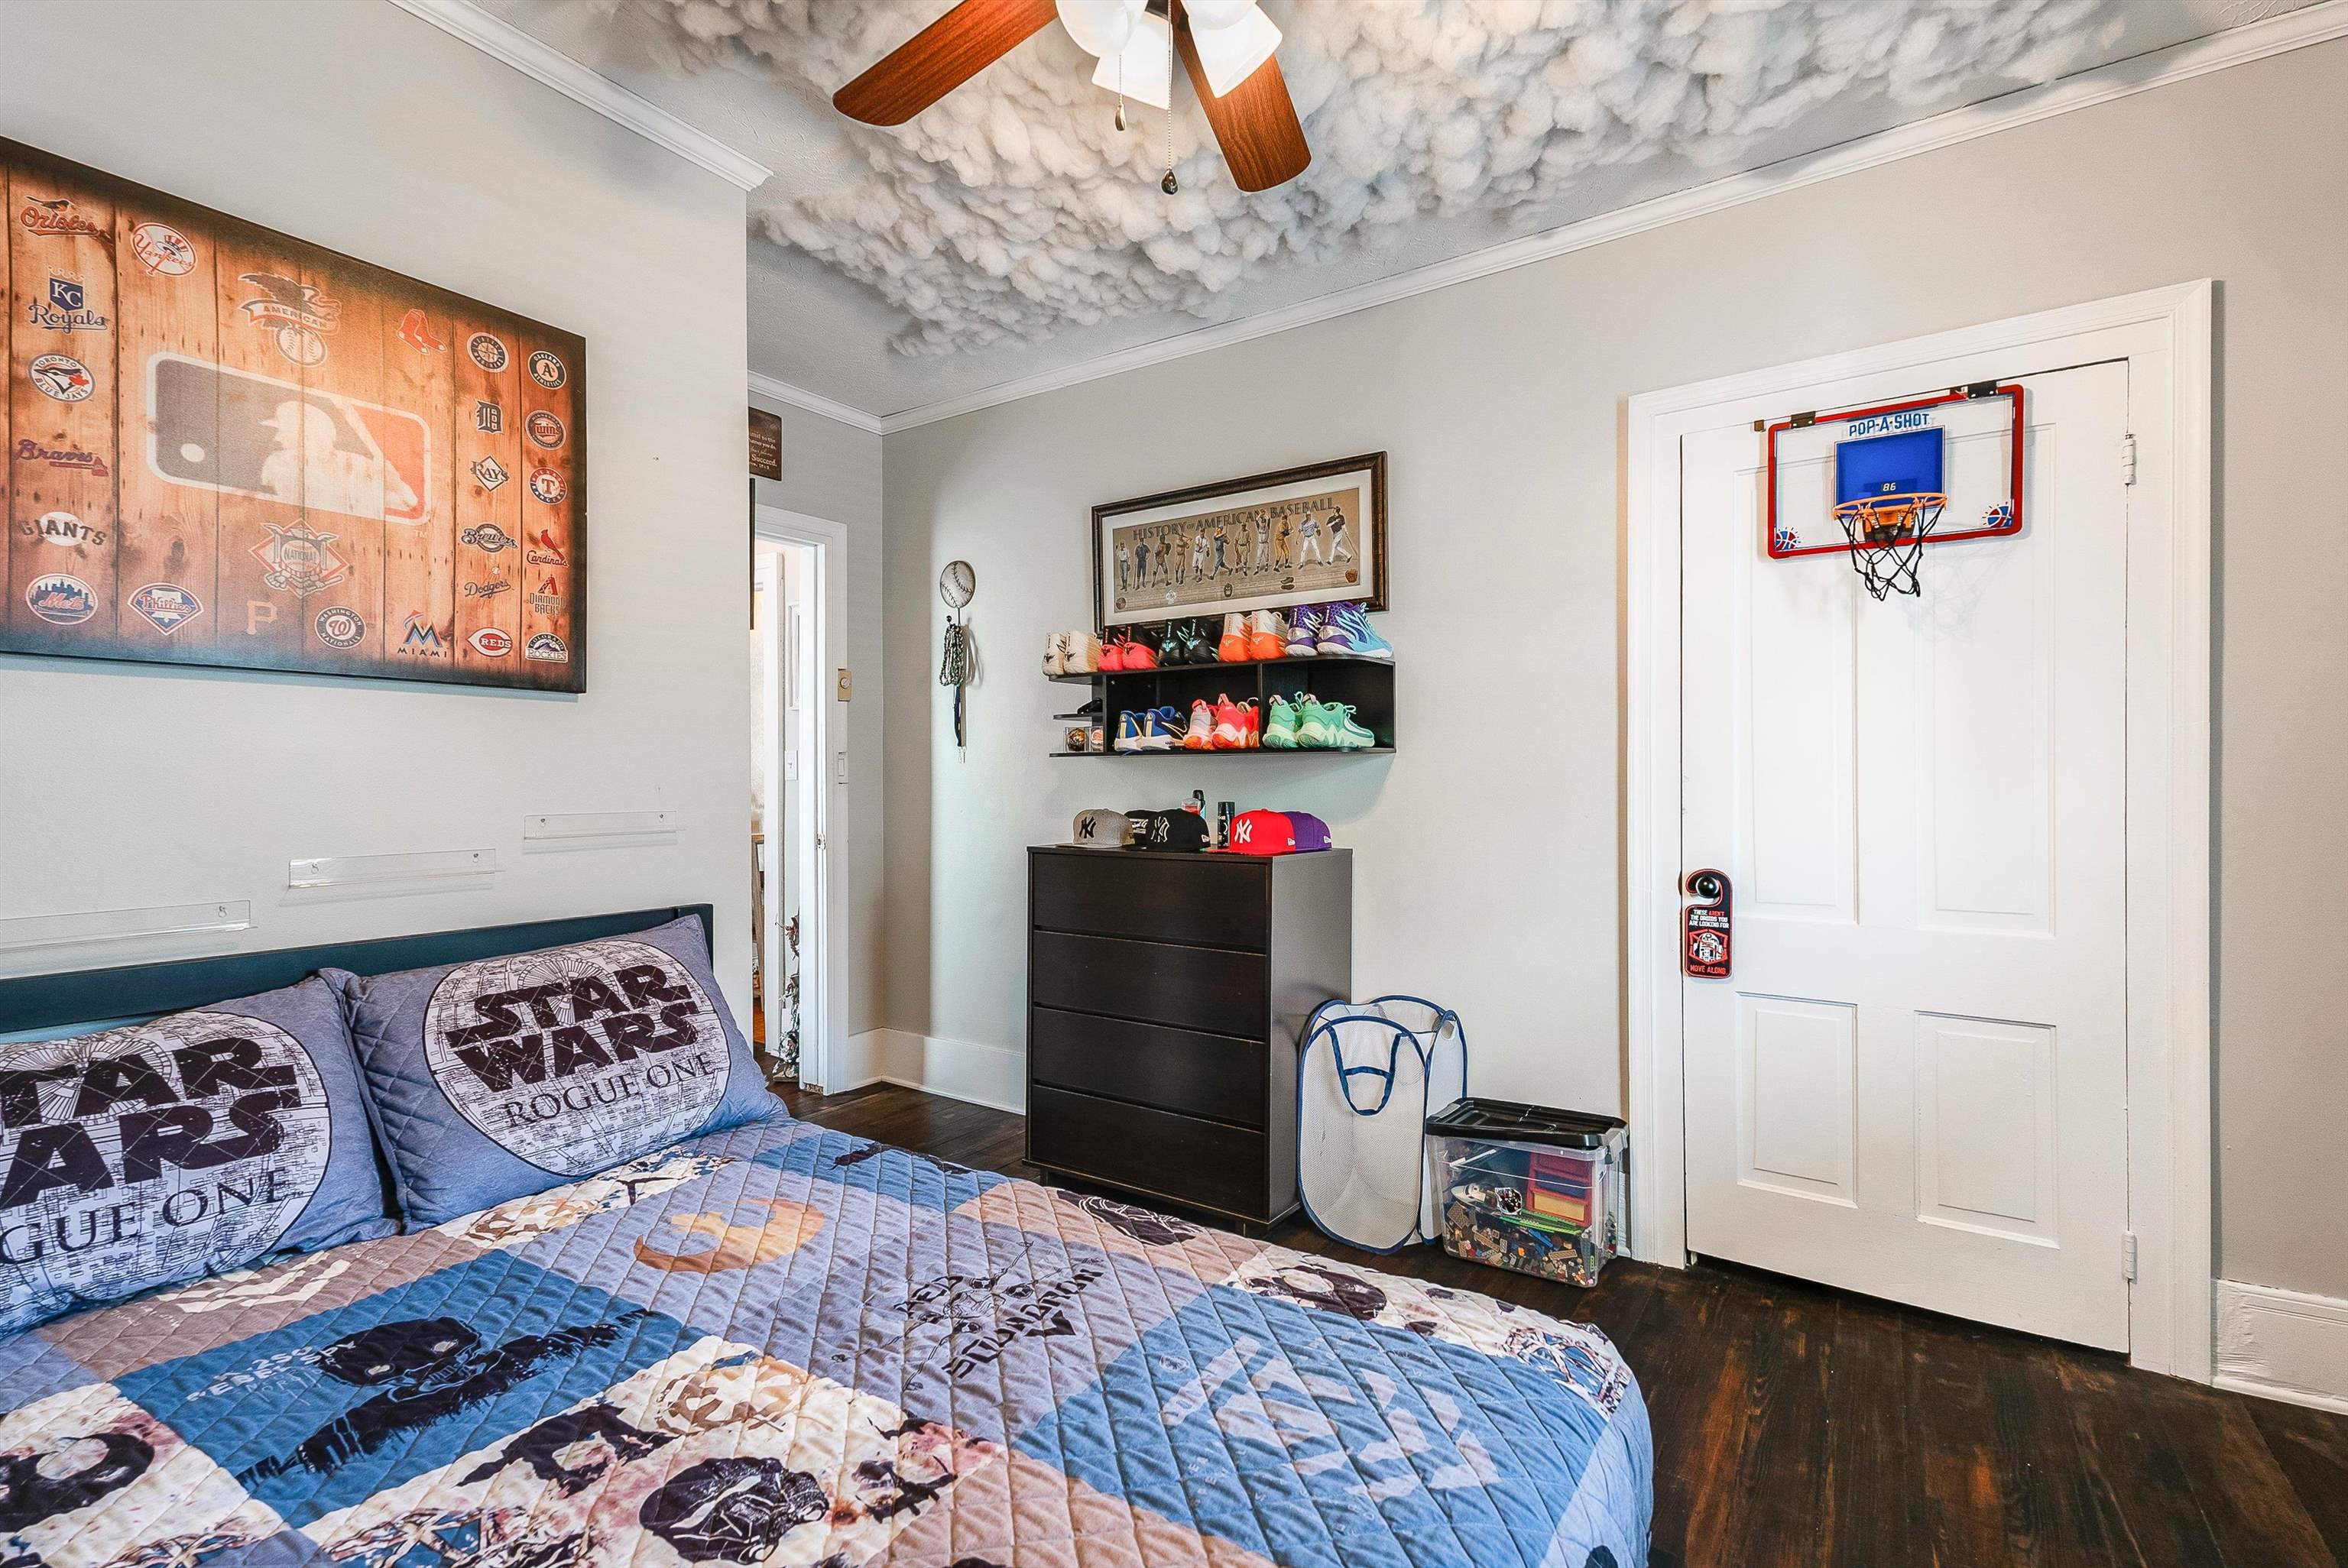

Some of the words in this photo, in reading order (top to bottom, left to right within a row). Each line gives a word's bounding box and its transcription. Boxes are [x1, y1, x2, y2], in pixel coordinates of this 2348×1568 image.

[21, 206, 99, 235] Orioles
[52, 281, 82, 307] KC
[28, 304, 107, 333] Royals
[34, 356, 77, 368] TORONTO
[34, 377, 60, 397] BLUE
[65, 387, 89, 400] JAYS
[1883, 481, 1896, 491] 86
[1133, 521, 1186, 541] HISTORY
[1270, 497, 1335, 520] BASEBALL
[18, 519, 106, 546] GIANTS
[461, 528, 518, 549] Brewers
[527, 549, 569, 569] Cardinals
[38, 591, 86, 611] Mets
[141, 594, 192, 613] Phillies
[319, 608, 363, 627] WASHINGTON
[320, 632, 362, 646] NATIONALS
[480, 637, 512, 648] REDS
[397, 647, 448, 659] MIAMI
[527, 650, 567, 660] ROCKIES
[1234, 818, 1253, 844] NY
[1689, 964, 1705, 973] MOVE
[444, 964, 692, 1049] STAR
[453, 1001, 699, 1093] WARS
[0, 1037, 298, 1129] TAR
[504, 1076, 642, 1129] ROGUE
[646, 1052, 716, 1089] ONE
[0, 1087, 302, 1210] ARS
[162, 1168, 290, 1227] ONE
